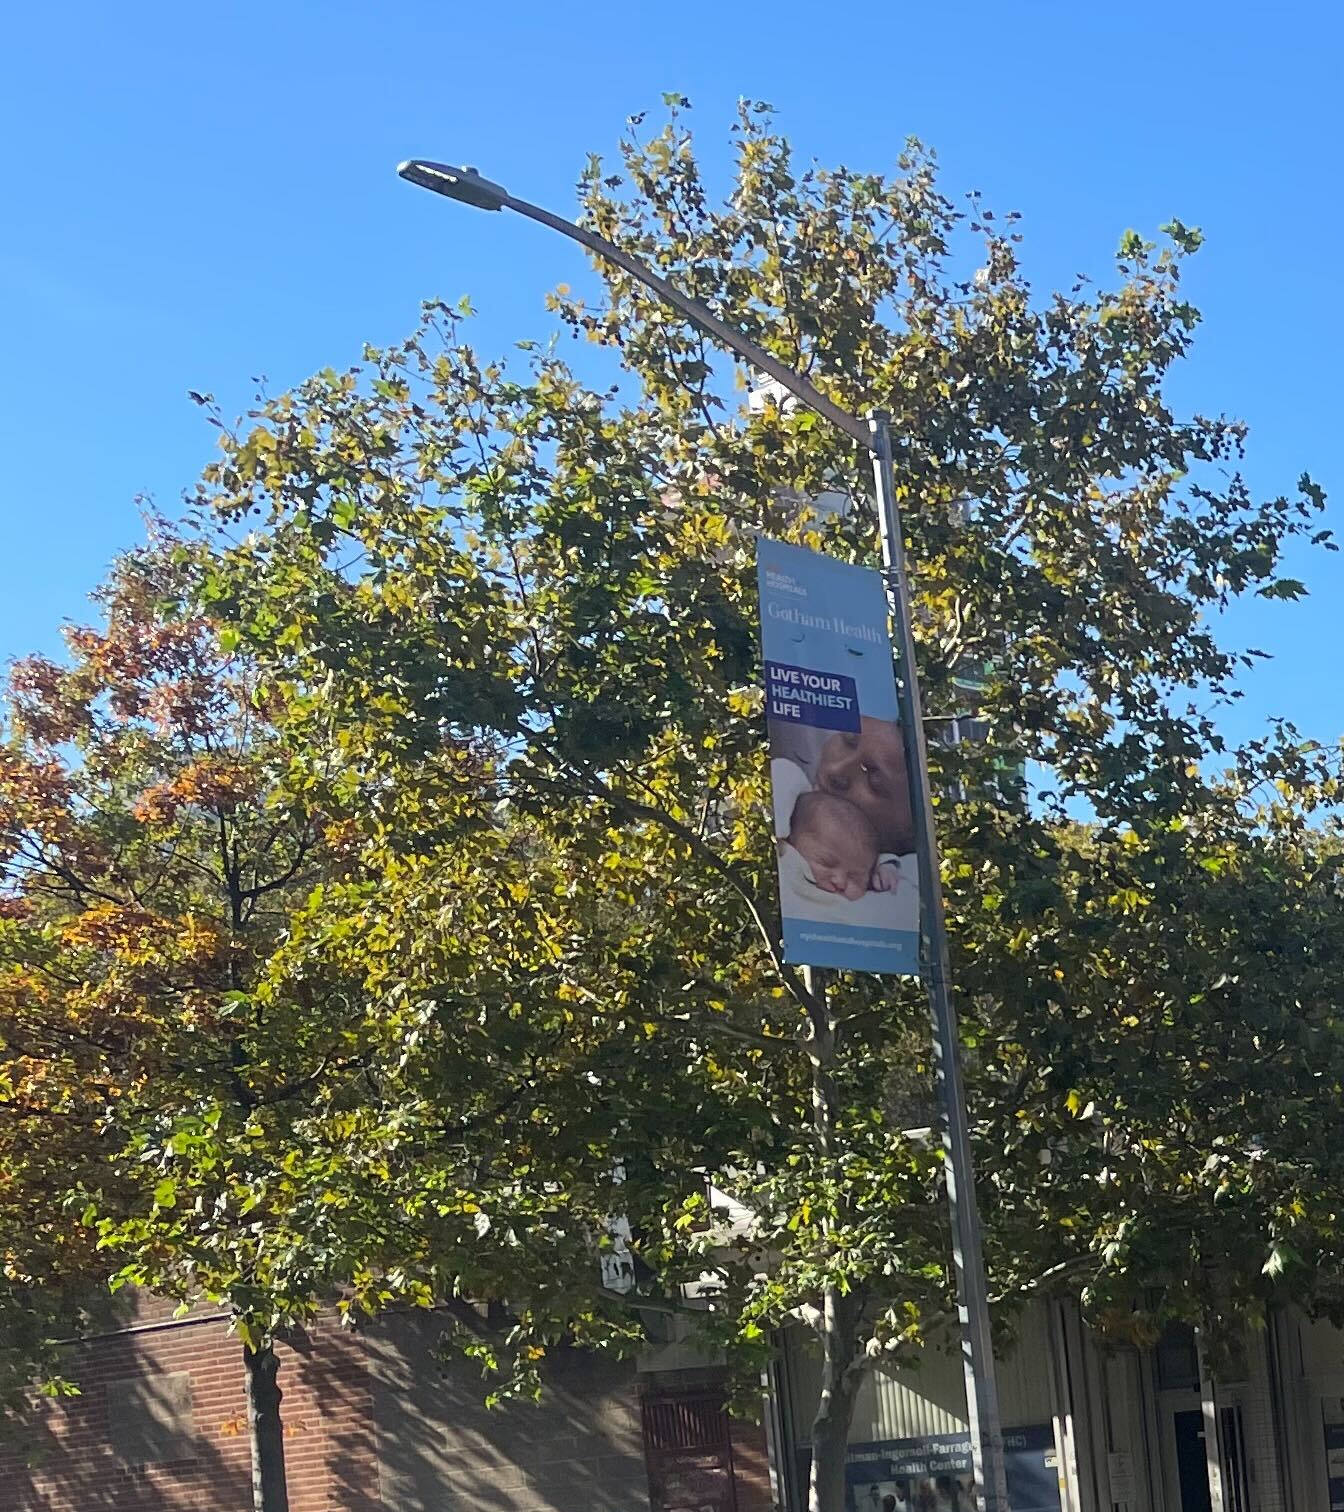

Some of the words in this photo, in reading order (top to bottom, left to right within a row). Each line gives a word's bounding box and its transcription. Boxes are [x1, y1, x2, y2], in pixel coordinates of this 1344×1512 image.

[768, 600, 831, 632] Gotham
[832, 616, 882, 645] Health
[770, 666, 800, 684] LIVE
[801, 672, 841, 692] YOUR
[772, 683, 853, 711] HEALTHIEST
[772, 700, 801, 718] LIFE
[889, 1461, 928, 1476] Health
[929, 1458, 968, 1474] Center
